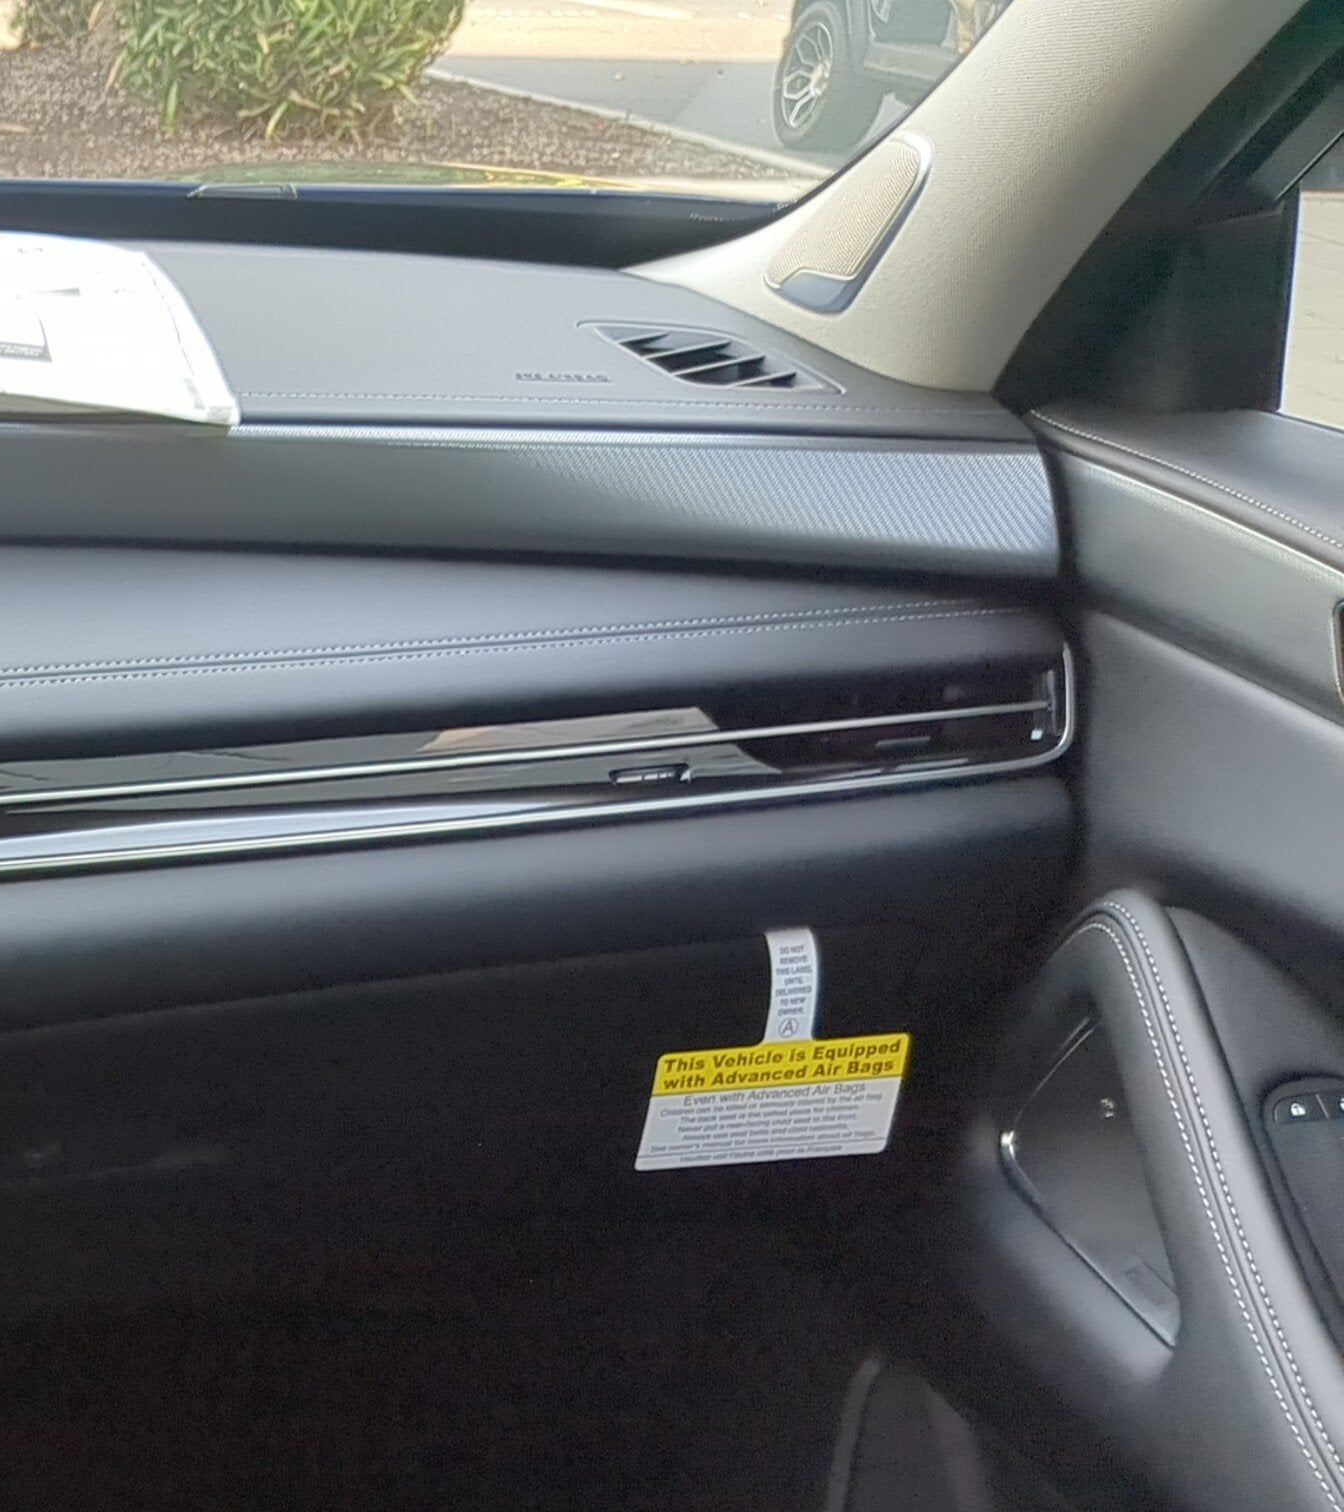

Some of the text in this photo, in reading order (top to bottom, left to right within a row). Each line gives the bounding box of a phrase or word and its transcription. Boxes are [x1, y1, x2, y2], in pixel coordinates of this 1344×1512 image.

[664, 1038, 902, 1074] This Vehicle is Equipped
[662, 1059, 894, 1090] with Advanced Air Bags
[683, 1094, 716, 1107] Even
[718, 1091, 745, 1103] with
[746, 1086, 811, 1102] Advanced
[812, 1084, 831, 1096] Air
[833, 1082, 866, 1096] Bags
